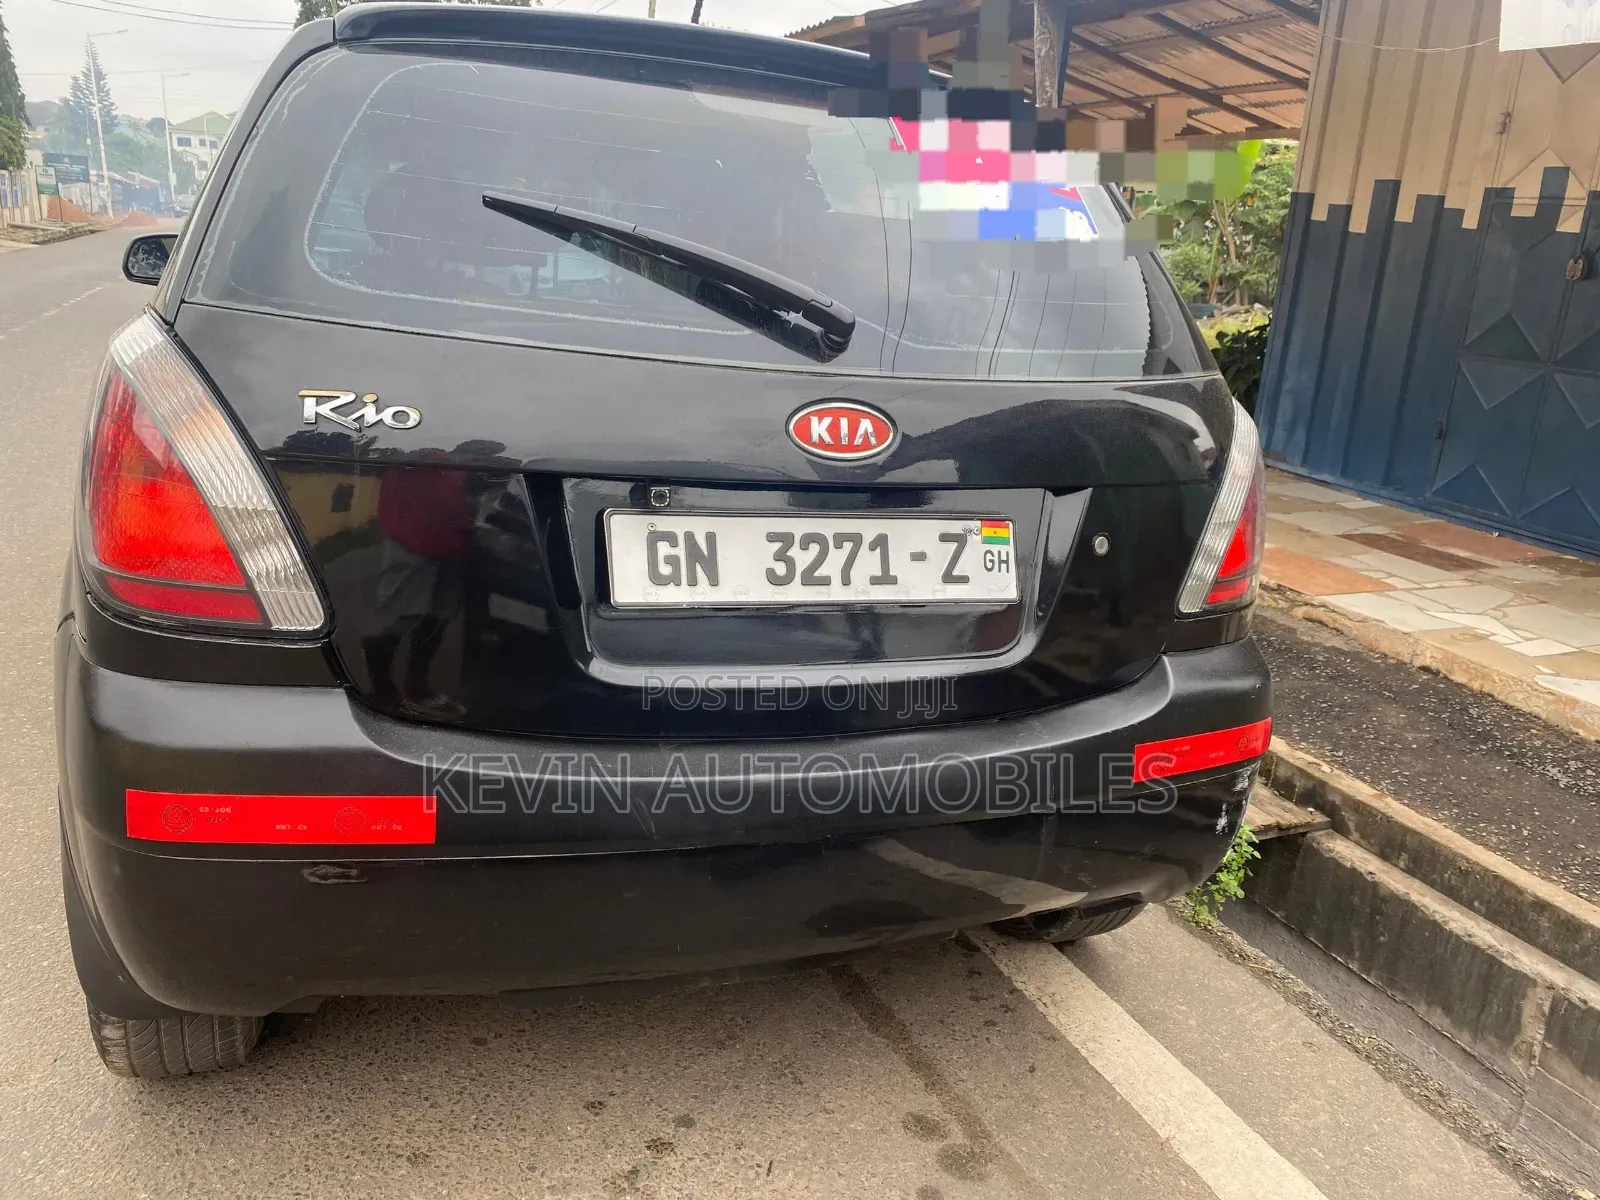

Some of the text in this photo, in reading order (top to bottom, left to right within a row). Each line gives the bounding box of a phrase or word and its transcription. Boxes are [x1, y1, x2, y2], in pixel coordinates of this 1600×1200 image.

[298, 389, 421, 432] Rio
[809, 415, 878, 447] KIA
[646, 531, 719, 587] GN
[983, 549, 1010, 574] GH
